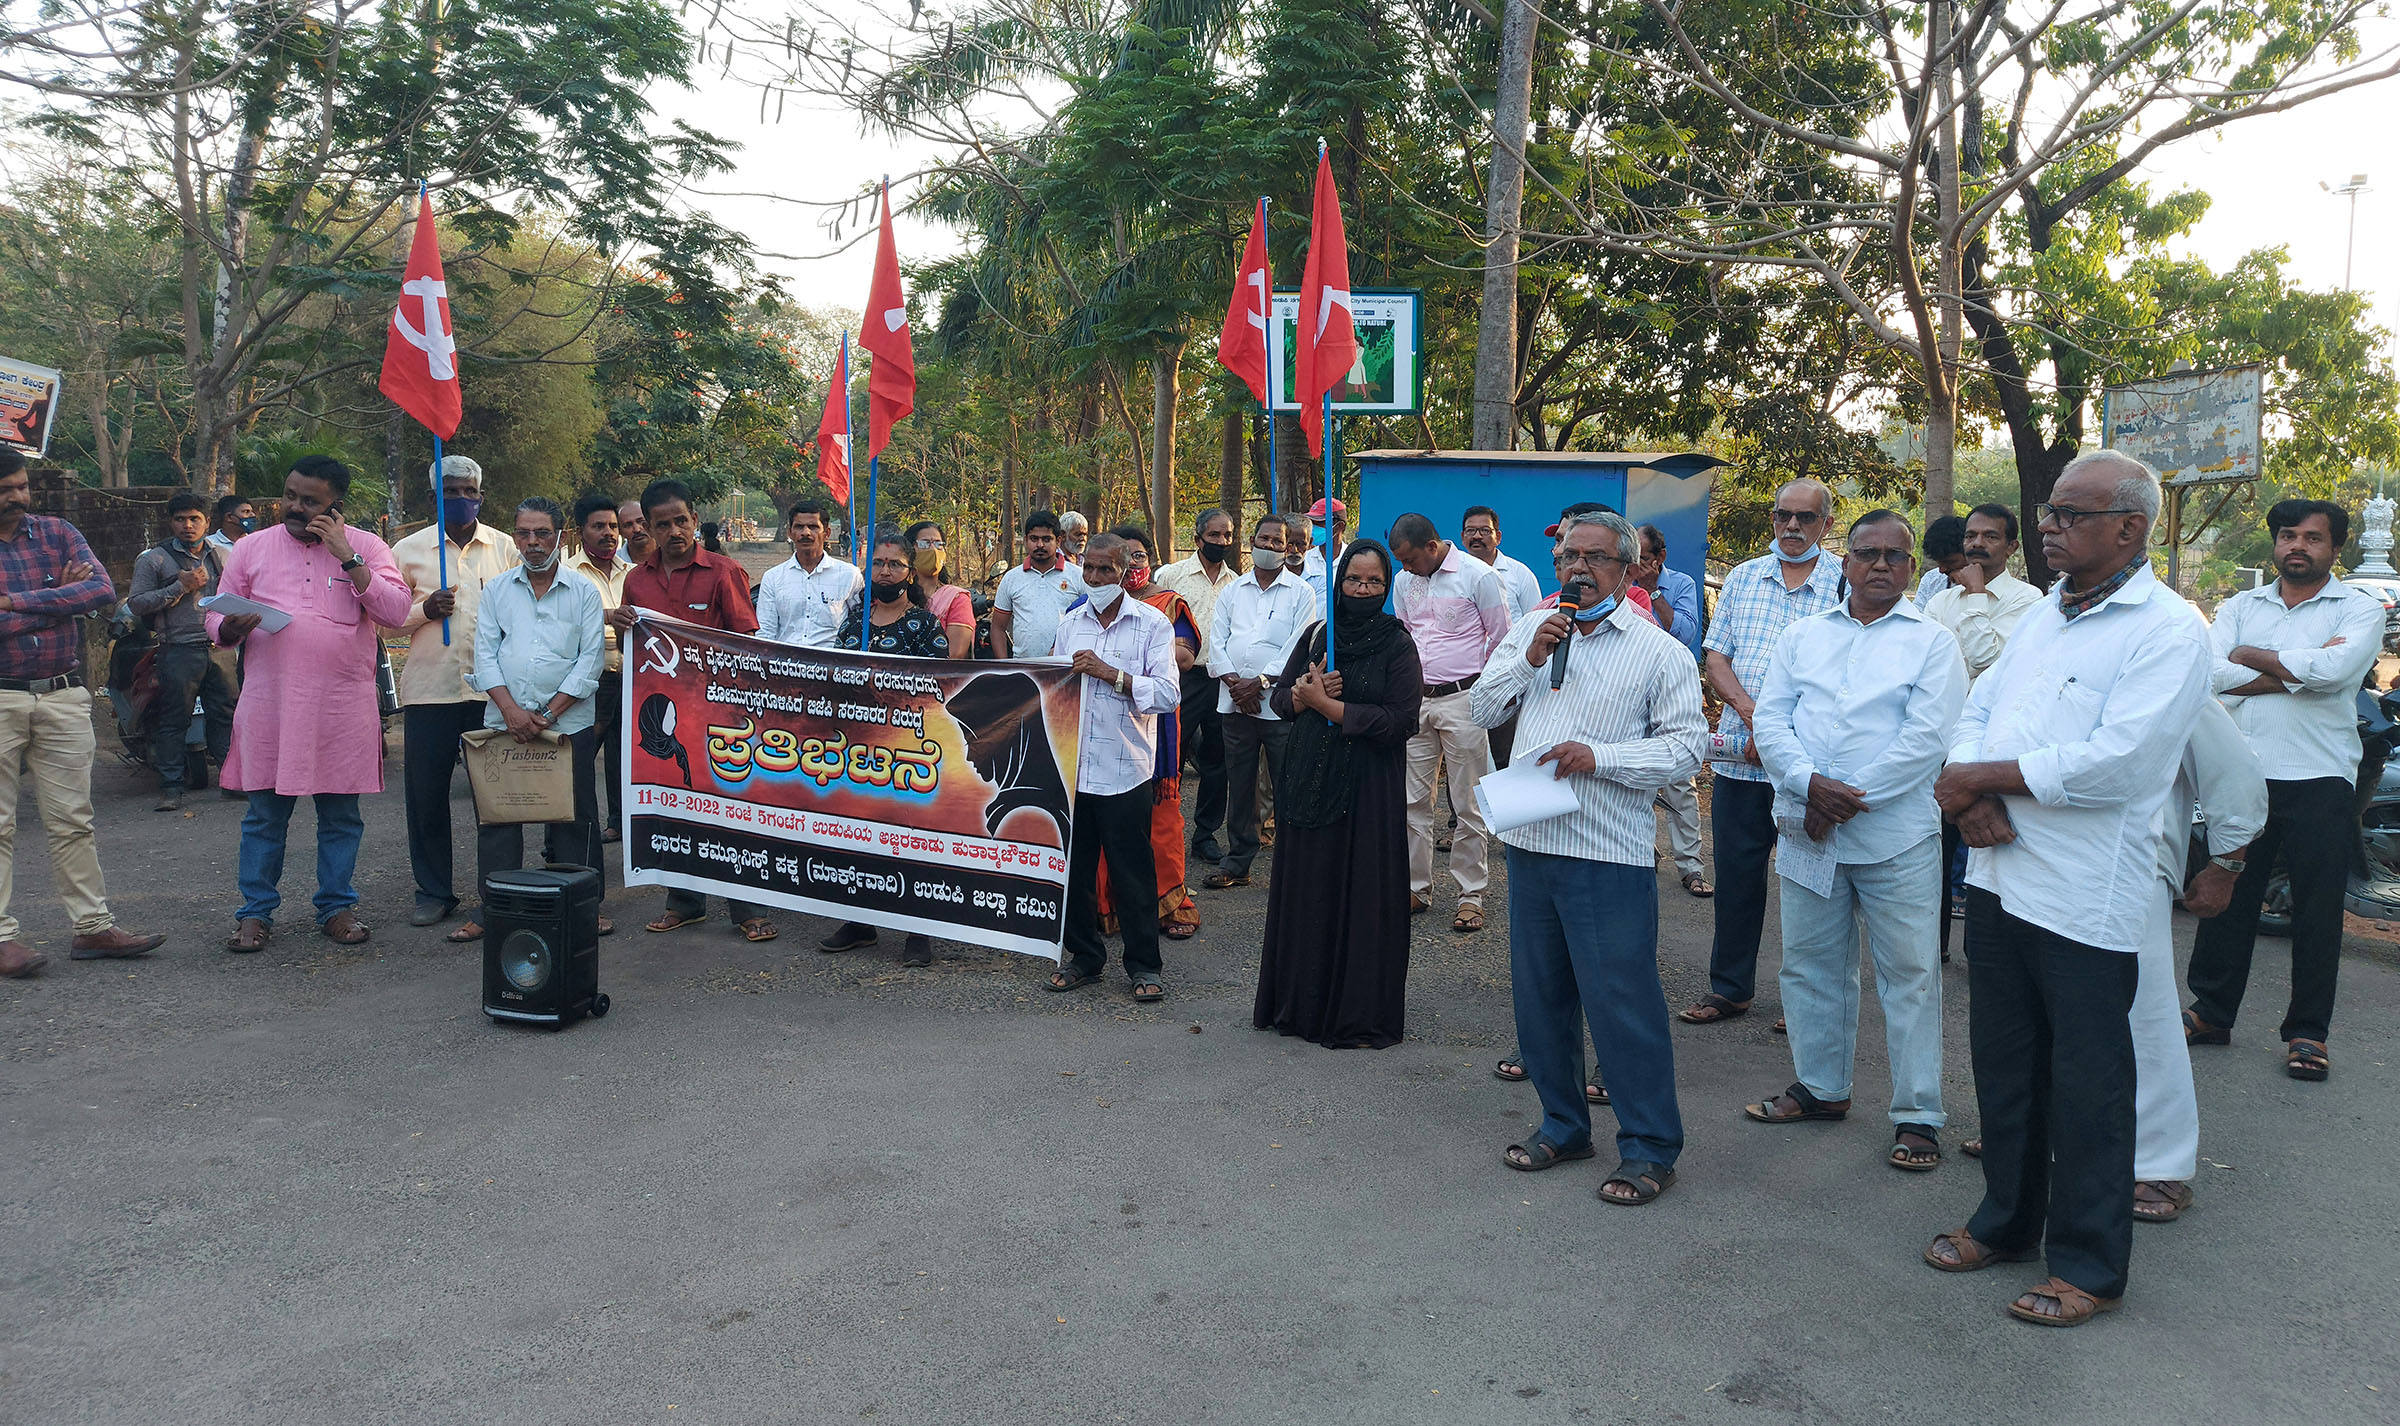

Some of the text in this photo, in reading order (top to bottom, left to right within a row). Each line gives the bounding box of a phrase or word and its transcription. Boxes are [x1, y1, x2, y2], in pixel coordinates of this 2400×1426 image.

[683, 644, 945, 703] ತನ್ನ ವೈಫಲ್ಯಗಳನ್ನು ಮರೆಮಾಚಲು ಹಿಜಾಬ್ ಧರಿಸುವುದನ್ನು
[807, 695, 834, 718] ಬಿಜೆಪಿ
[838, 700, 888, 725] ಸರಕಾರದ
[706, 718, 942, 794] ಪ್ರತಿಭಟನೆ
[637, 789, 1066, 873] 11-02-2022 ಸಂಜೆ 5ಗಂಟೆಗೆ ಉಡುಪಿಯ ಅಜ್ಜರಕಾಡು ಹುತಾತ್ಮಚೌಕದ ಬಳಿ
[650, 832, 692, 855] ಭಾರತ
[697, 838, 769, 881] ಕಮ್ಯೂನಿಸ್ಟ್
[775, 853, 800, 885] ಪಕ್ಷ
[914, 878, 965, 904] ಉಡುಪಿ
[972, 888, 1008, 919] ಜಿಲ್ಲಾ
[1015, 892, 1057, 921] ಸಮಿತಿ
